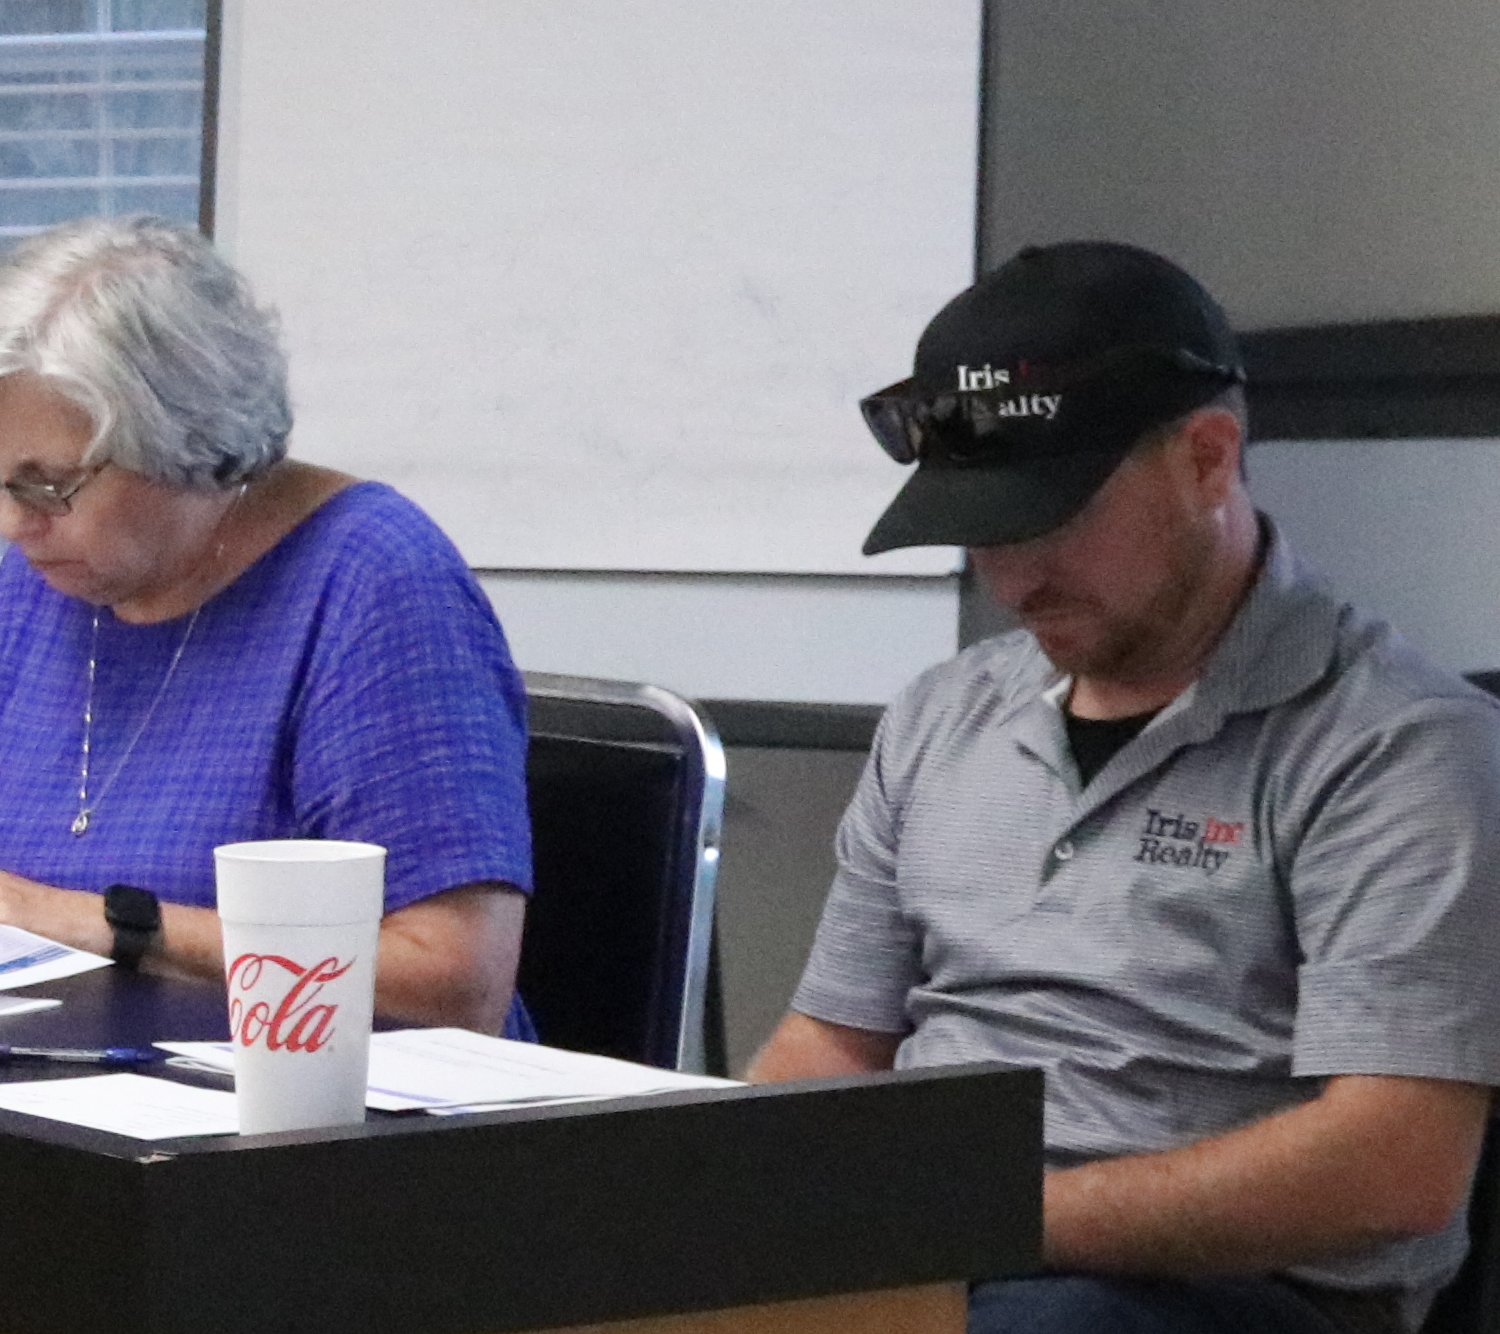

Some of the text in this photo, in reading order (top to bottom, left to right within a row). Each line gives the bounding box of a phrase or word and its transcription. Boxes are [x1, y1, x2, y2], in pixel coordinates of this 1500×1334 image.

[1145, 808, 1199, 840] Iris
[1133, 837, 1229, 877] Realty
[228, 953, 358, 1053] Cola
